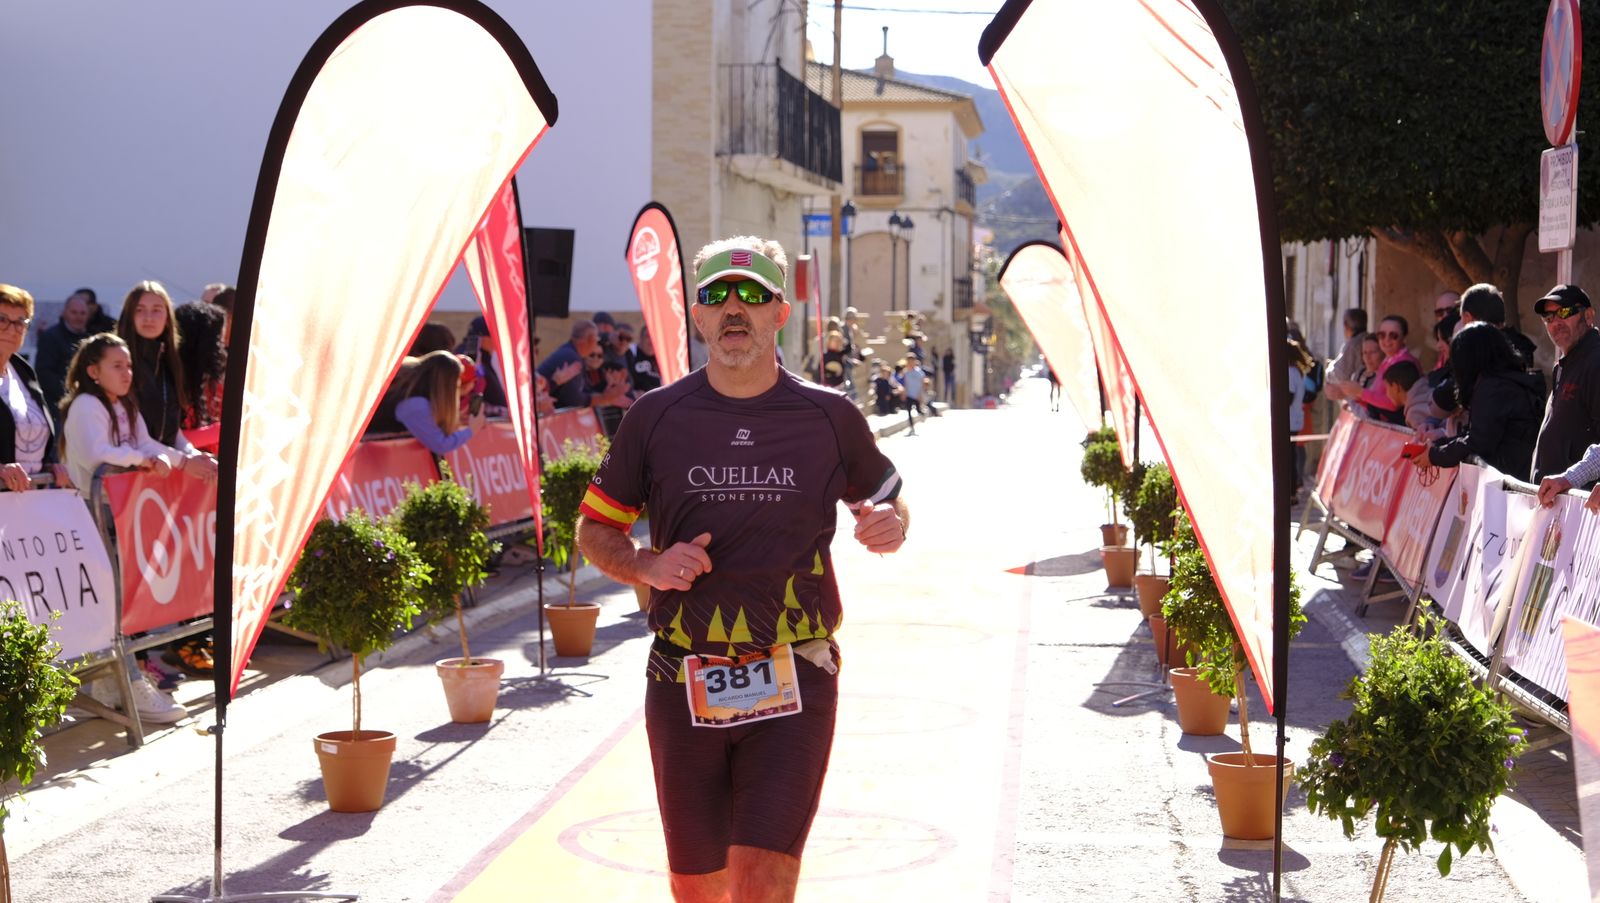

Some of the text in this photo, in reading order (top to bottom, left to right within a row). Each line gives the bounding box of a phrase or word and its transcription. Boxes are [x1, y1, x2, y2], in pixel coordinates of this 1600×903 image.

[701, 493, 782, 503] STONE 1958
[54, 529, 85, 554] DE
[706, 662, 772, 694] 381
[718, 690, 767, 703] RICARDO MANUEL
